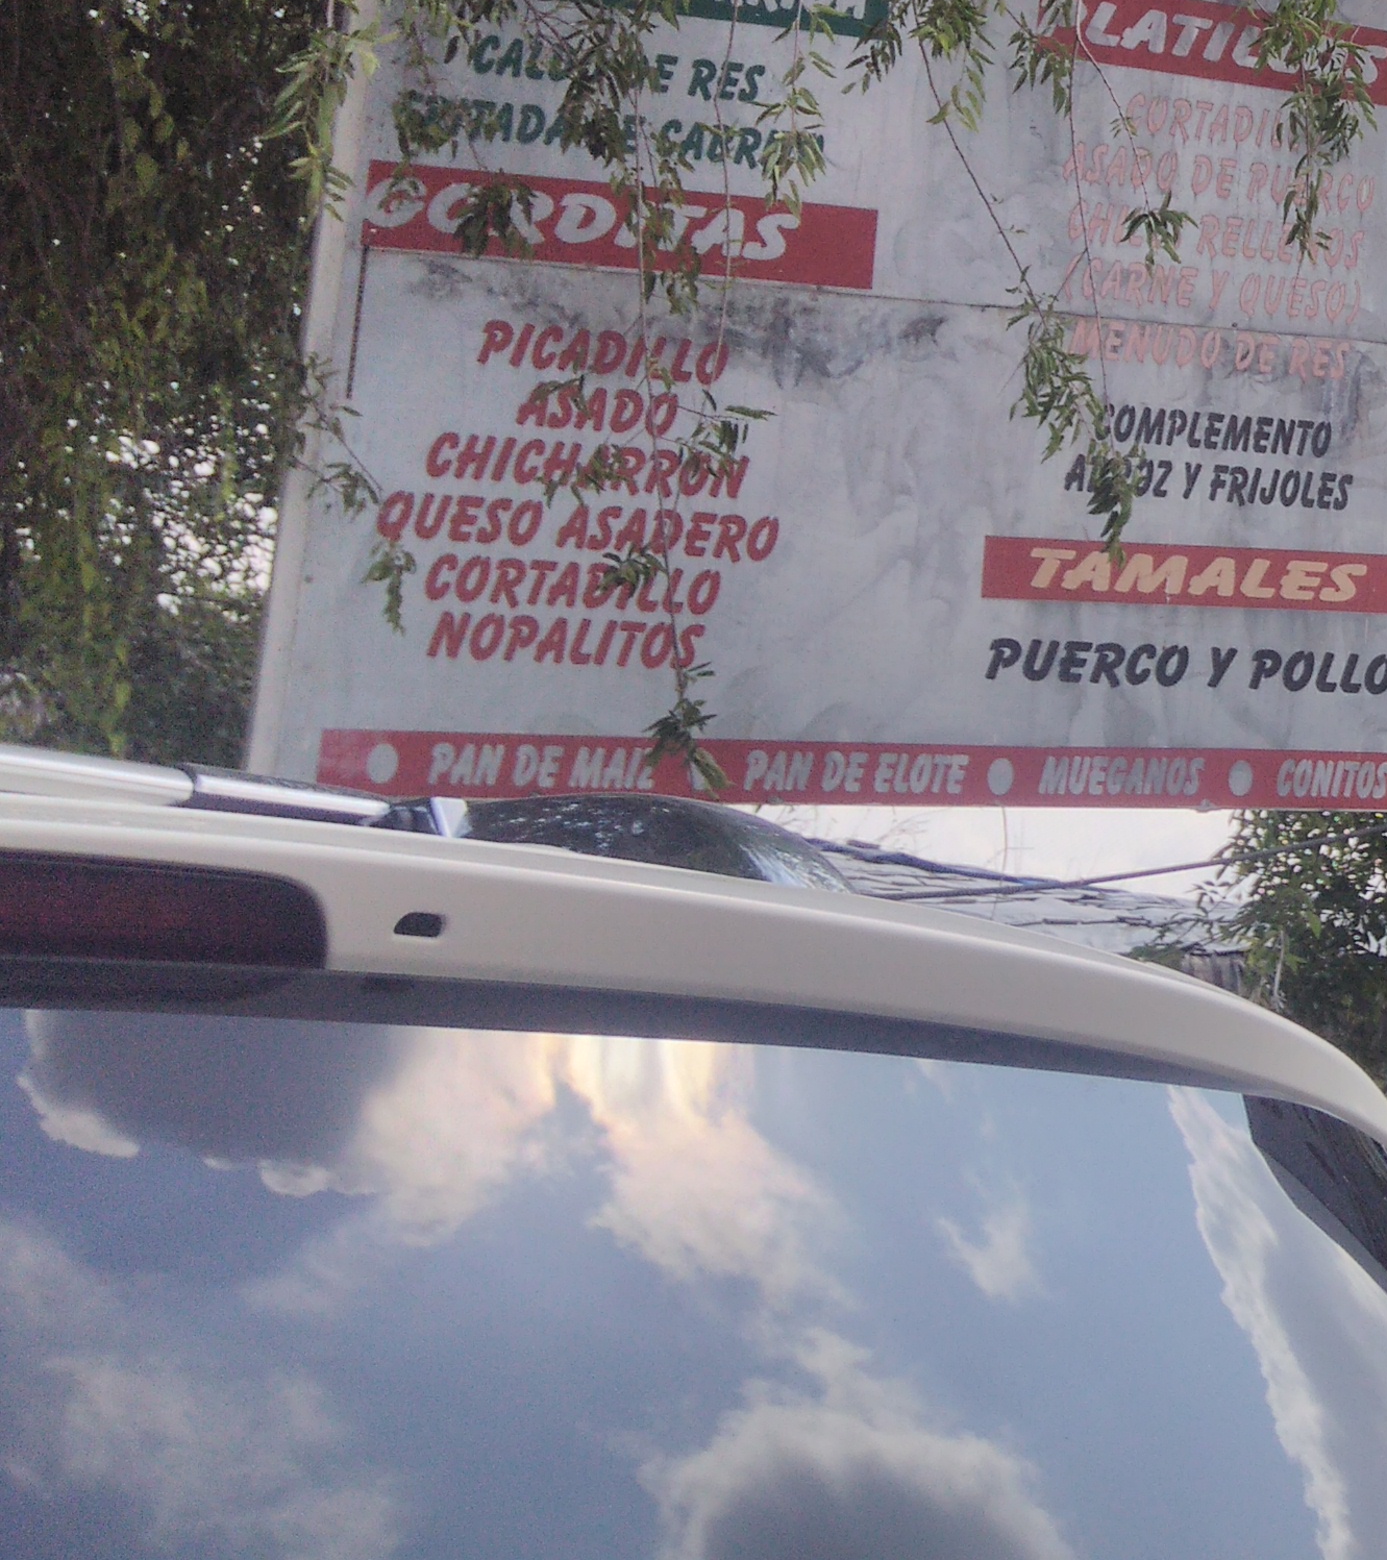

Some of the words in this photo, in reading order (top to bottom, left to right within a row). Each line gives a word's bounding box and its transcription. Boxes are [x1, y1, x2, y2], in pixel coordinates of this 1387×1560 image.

[686, 58, 766, 102] RES
[1062, 140, 1179, 192] ASADO
[1192, 154, 1238, 199] DE
[1063, 252, 1199, 308] (CARNE
[1208, 269, 1231, 311] Y
[1239, 272, 1361, 325] QUESO)
[477, 319, 731, 386] PICADILLO
[1068, 316, 1223, 369] MENUDO
[1235, 329, 1281, 374] DE
[1288, 335, 1352, 383] RES
[515, 381, 679, 438] ASADO
[1181, 462, 1203, 501] Y
[1209, 464, 1354, 512] FRIJOLES
[376, 490, 544, 547] QUESO
[556, 502, 780, 564] ASADERO
[424, 552, 722, 616] CORTADILLO
[1029, 546, 1369, 603] TAMALES
[426, 610, 707, 670] NOPALITOS
[985, 636, 1190, 688] PUERCO
[1206, 644, 1238, 689] Y
[427, 742, 505, 787] PAN
[511, 743, 565, 789] DE
[744, 748, 816, 793] PAN
[821, 750, 869, 793] DE
[874, 752, 970, 796] ELOTE
[1037, 754, 1206, 797] MUEGANOS
